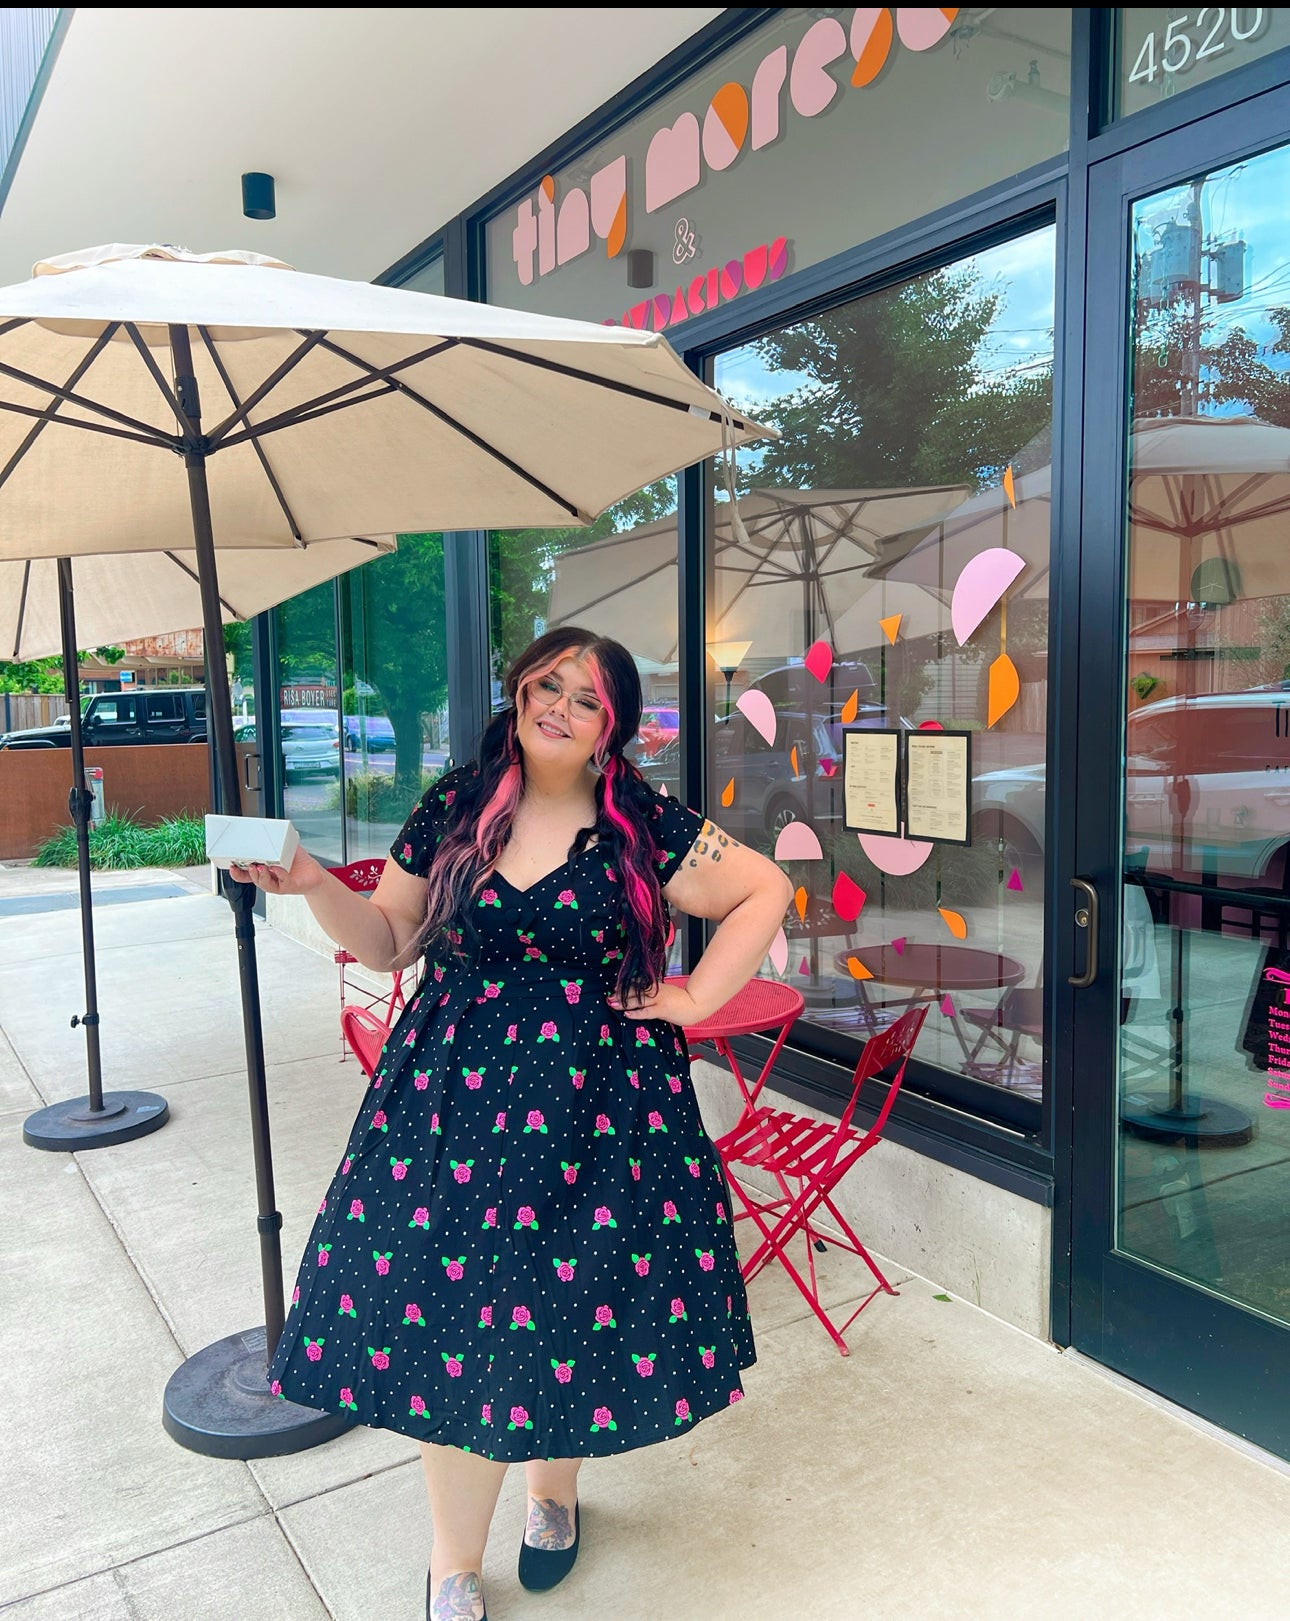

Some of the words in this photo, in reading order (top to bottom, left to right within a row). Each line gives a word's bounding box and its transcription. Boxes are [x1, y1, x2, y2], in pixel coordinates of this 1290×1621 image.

[512, 154, 628, 286] tiny
[671, 217, 697, 265] &
[283, 689, 300, 706] RISA
[301, 689, 325, 706] BOYER
[1268, 1005, 1290, 1019] Mon
[1268, 1030, 1290, 1044] Wed
